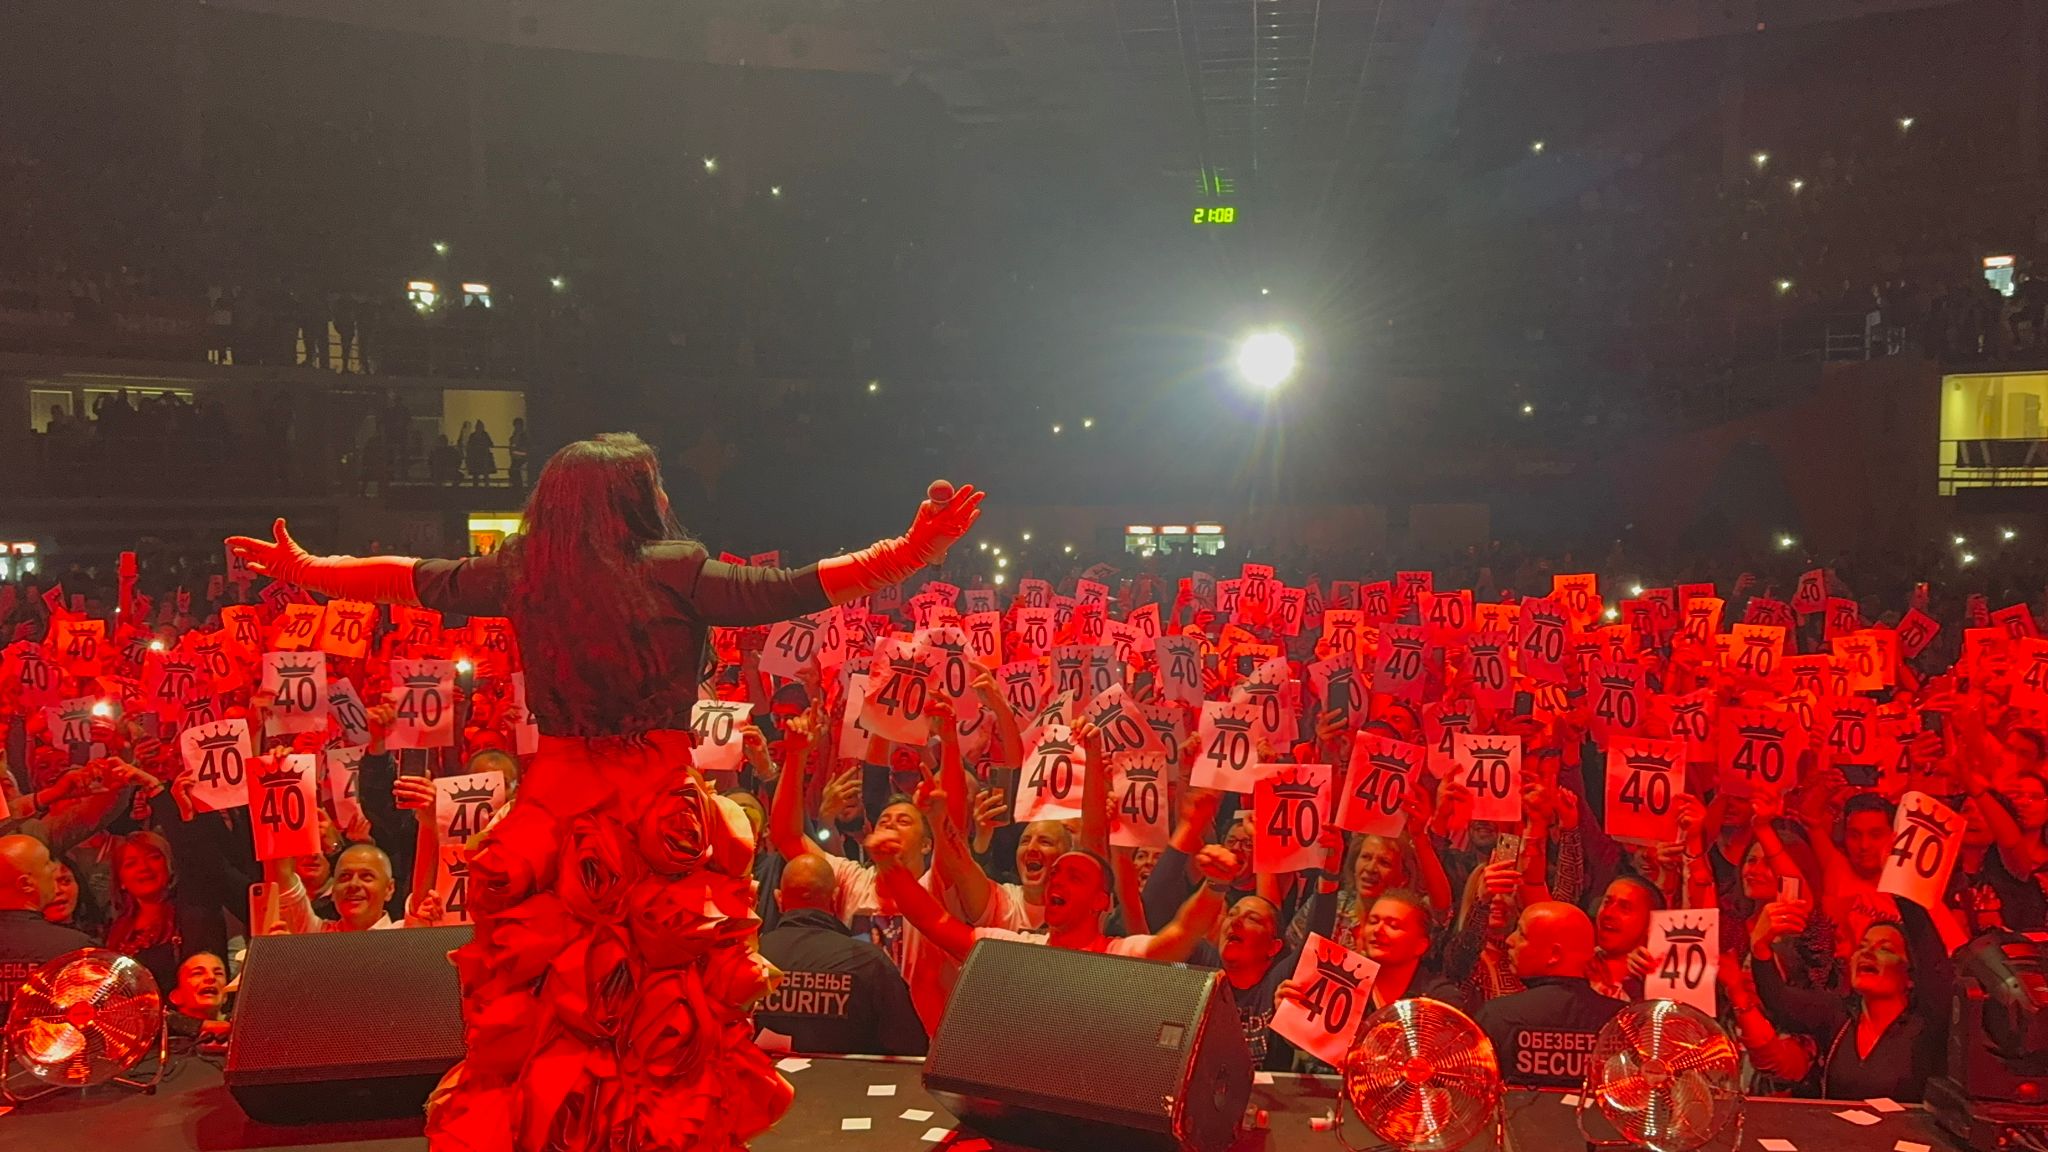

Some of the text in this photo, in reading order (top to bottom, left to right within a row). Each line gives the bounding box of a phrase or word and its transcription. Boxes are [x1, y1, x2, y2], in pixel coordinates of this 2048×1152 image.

[1193, 208, 1233, 223] 21:08
[1245, 581, 1266, 602] 40
[1367, 596, 1389, 616] 40
[1801, 586, 1820, 602] 40
[284, 621, 312, 638] 40
[1082, 618, 1103, 638] 40
[1430, 598, 1464, 629] 40
[1833, 612, 1855, 633] 40
[236, 620, 260, 645] 40
[330, 622, 361, 644] 40
[776, 627, 815, 662] 40
[970, 631, 994, 656] 40
[1023, 625, 1048, 649] 40
[1328, 629, 1356, 653] 40
[1524, 625, 1563, 662] 40
[1684, 617, 1709, 644] 40
[1901, 627, 1923, 648] 40
[68, 637, 96, 661] 40
[1384, 649, 1421, 681] 40
[1737, 646, 1773, 677] 40
[21, 660, 49, 691] 40
[1058, 668, 1083, 702] 40
[1169, 655, 1199, 688] 40
[1472, 656, 1504, 690] 40
[157, 673, 195, 704] 40
[274, 678, 317, 713] 40
[877, 674, 926, 720] 40
[1008, 682, 1036, 713] 40
[1536, 685, 1571, 713] 40
[336, 703, 369, 735] 40
[398, 689, 442, 728] 40
[1597, 689, 1637, 728] 40
[690, 711, 734, 747] 40
[1671, 710, 1710, 742] 40
[1828, 719, 1866, 755] 40
[1207, 730, 1250, 771] 40
[1733, 740, 1785, 783] 40
[198, 746, 244, 788] 40
[1027, 754, 1074, 800] 40
[1466, 759, 1511, 799] 40
[1121, 782, 1159, 825] 40
[1356, 768, 1405, 815] 40
[1620, 770, 1671, 815] 40
[261, 785, 306, 833] 40
[1267, 799, 1320, 847] 40
[1890, 823, 1944, 879] 40
[1660, 944, 1707, 990] 40
[1301, 975, 1353, 1034] 40
